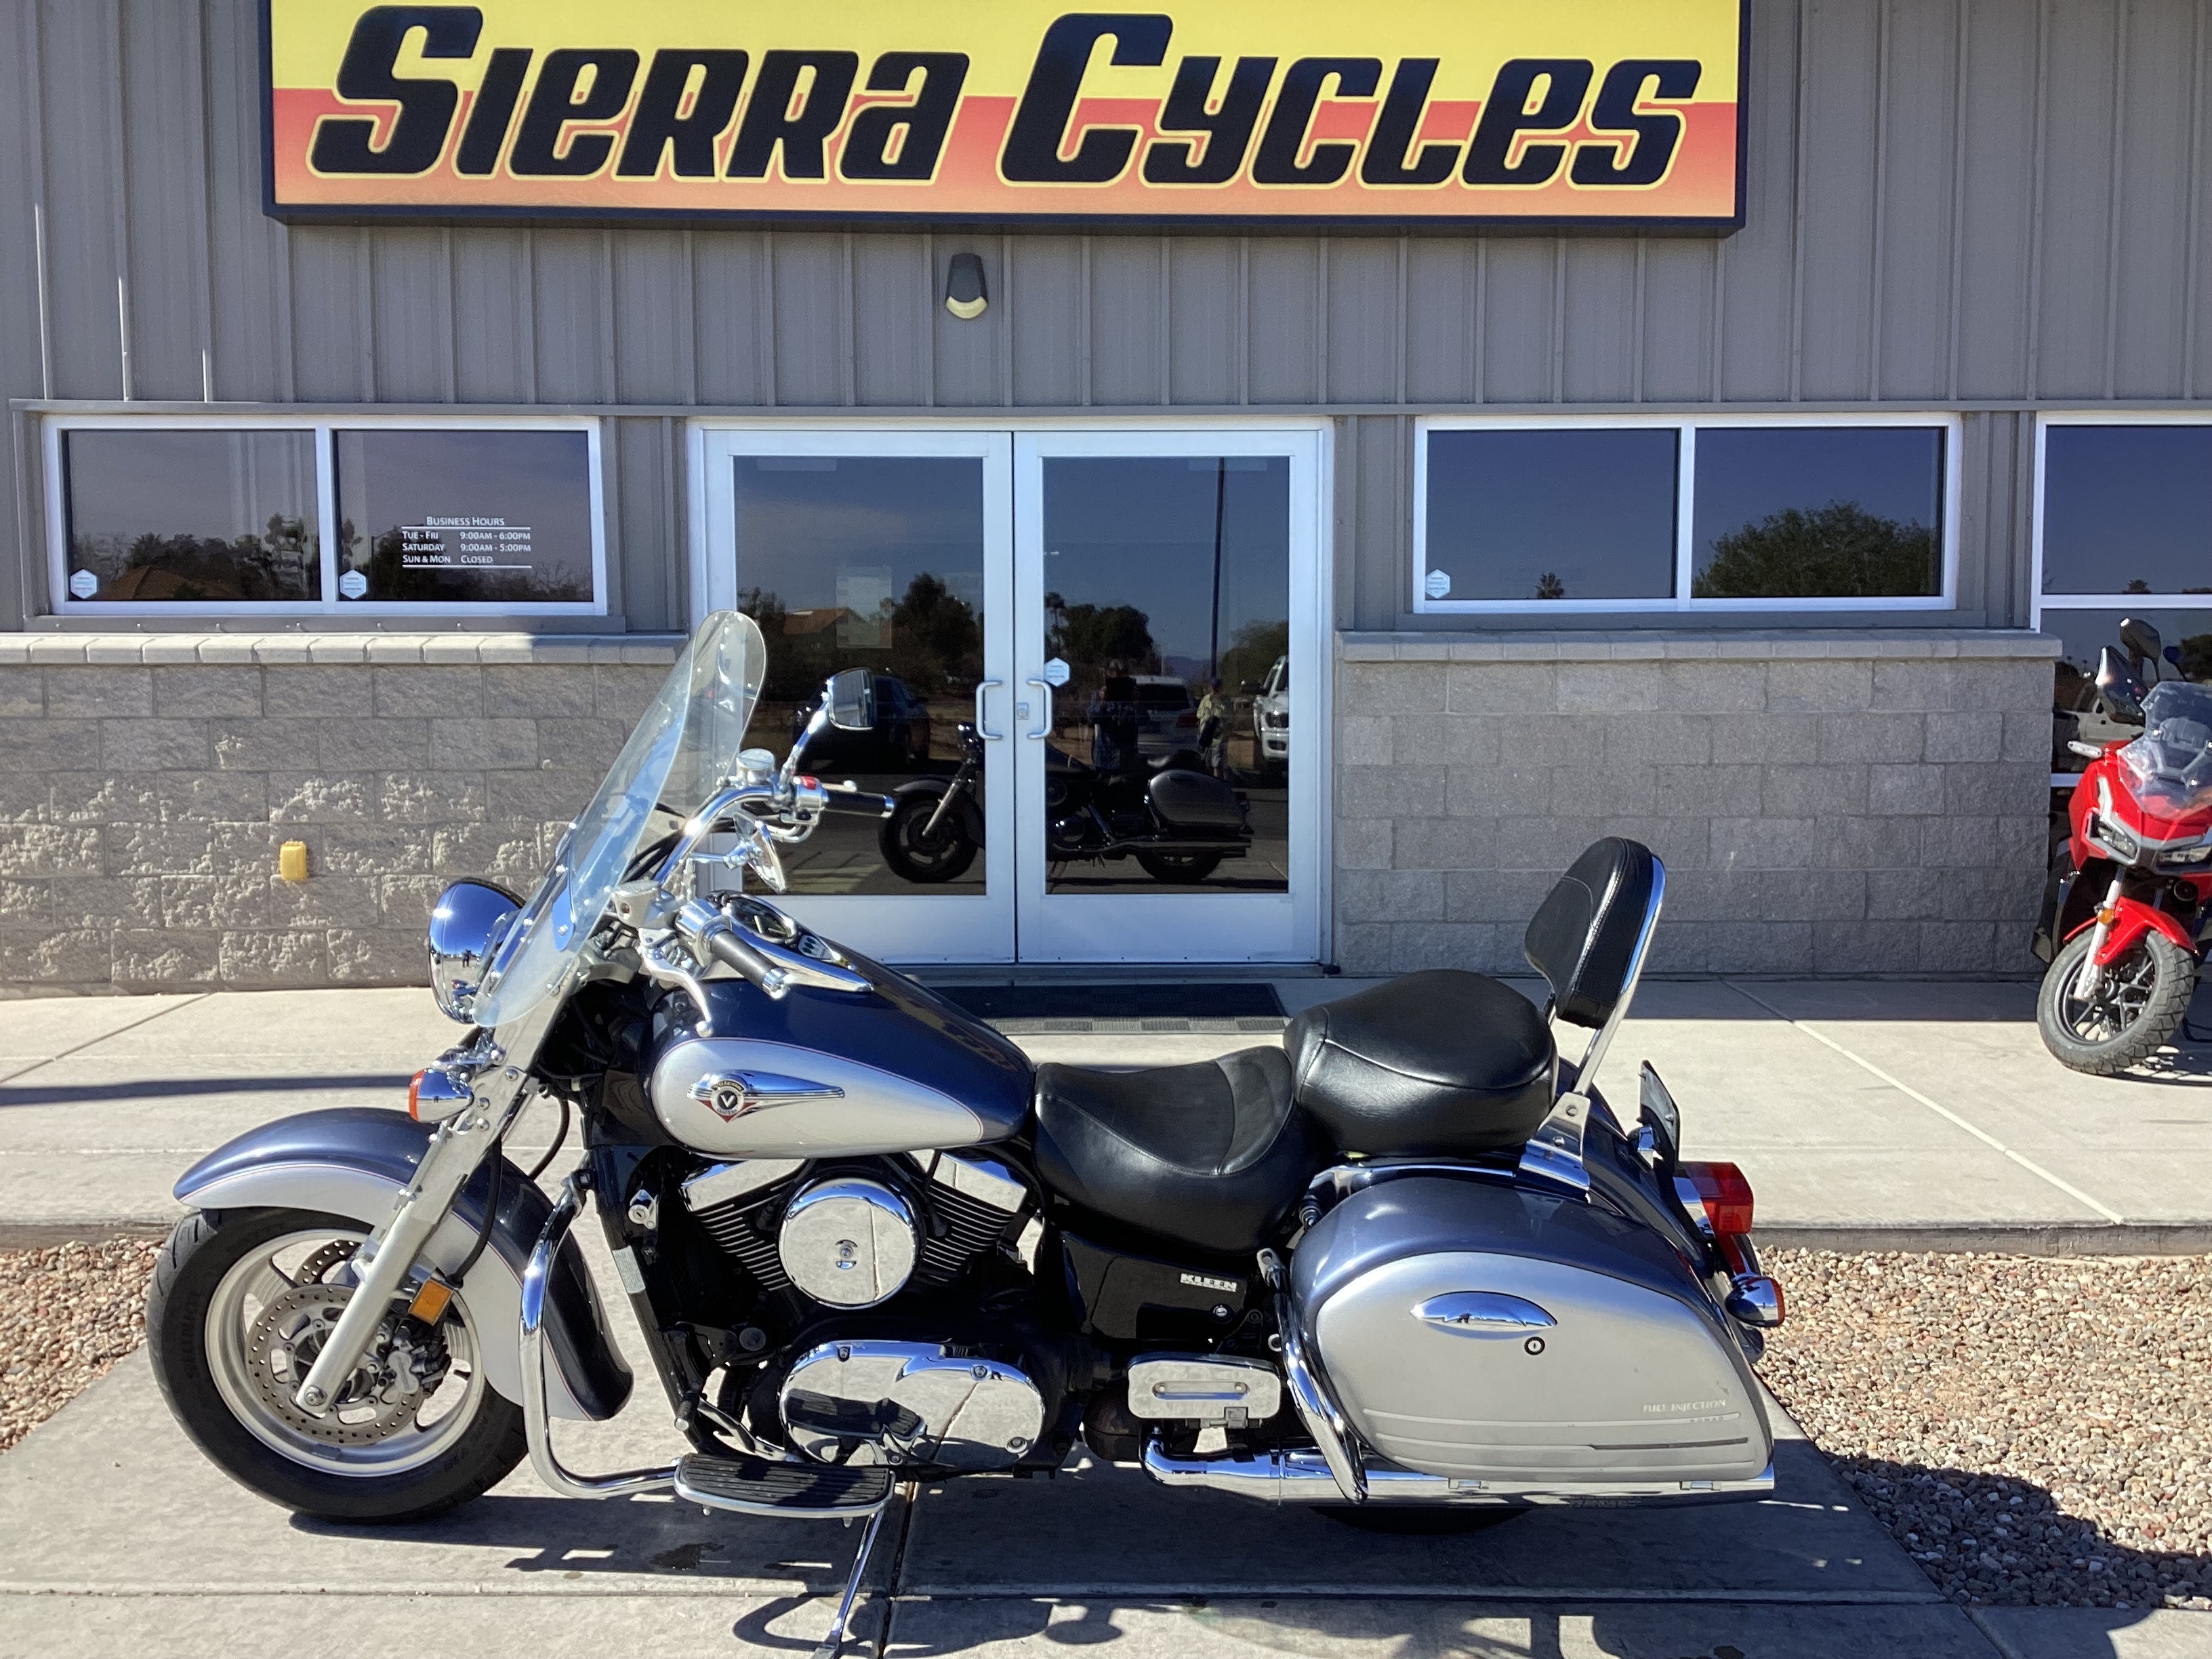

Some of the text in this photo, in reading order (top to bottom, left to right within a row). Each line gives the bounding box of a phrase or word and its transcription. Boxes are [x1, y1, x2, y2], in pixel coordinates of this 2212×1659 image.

[499, 532, 531, 540] 6:00PM
[459, 544, 493, 552] 9:00AM
[499, 544, 531, 552] 5:00PM
[422, 555, 428, 563] &
[720, 1094, 735, 1108] V
[1180, 1273, 1237, 1292] KLEEN
[1643, 1399, 1726, 1413] FUEL INJECTION
